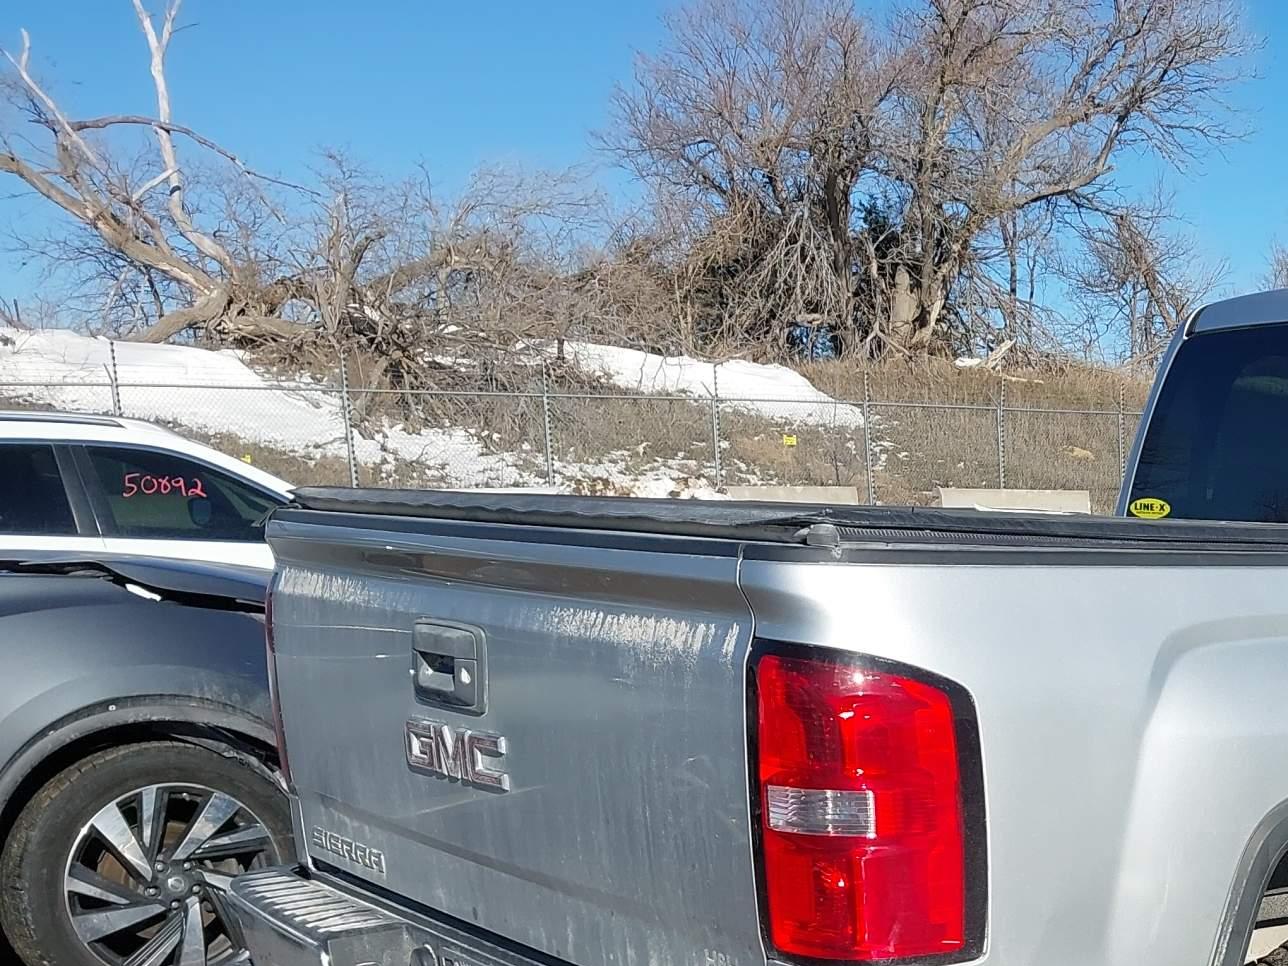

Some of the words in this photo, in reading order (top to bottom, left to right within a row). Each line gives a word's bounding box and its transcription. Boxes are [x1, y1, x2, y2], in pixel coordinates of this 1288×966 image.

[122, 472, 208, 498] 50892
[404, 715, 511, 794] GMC
[311, 825, 387, 877] SIERRA
